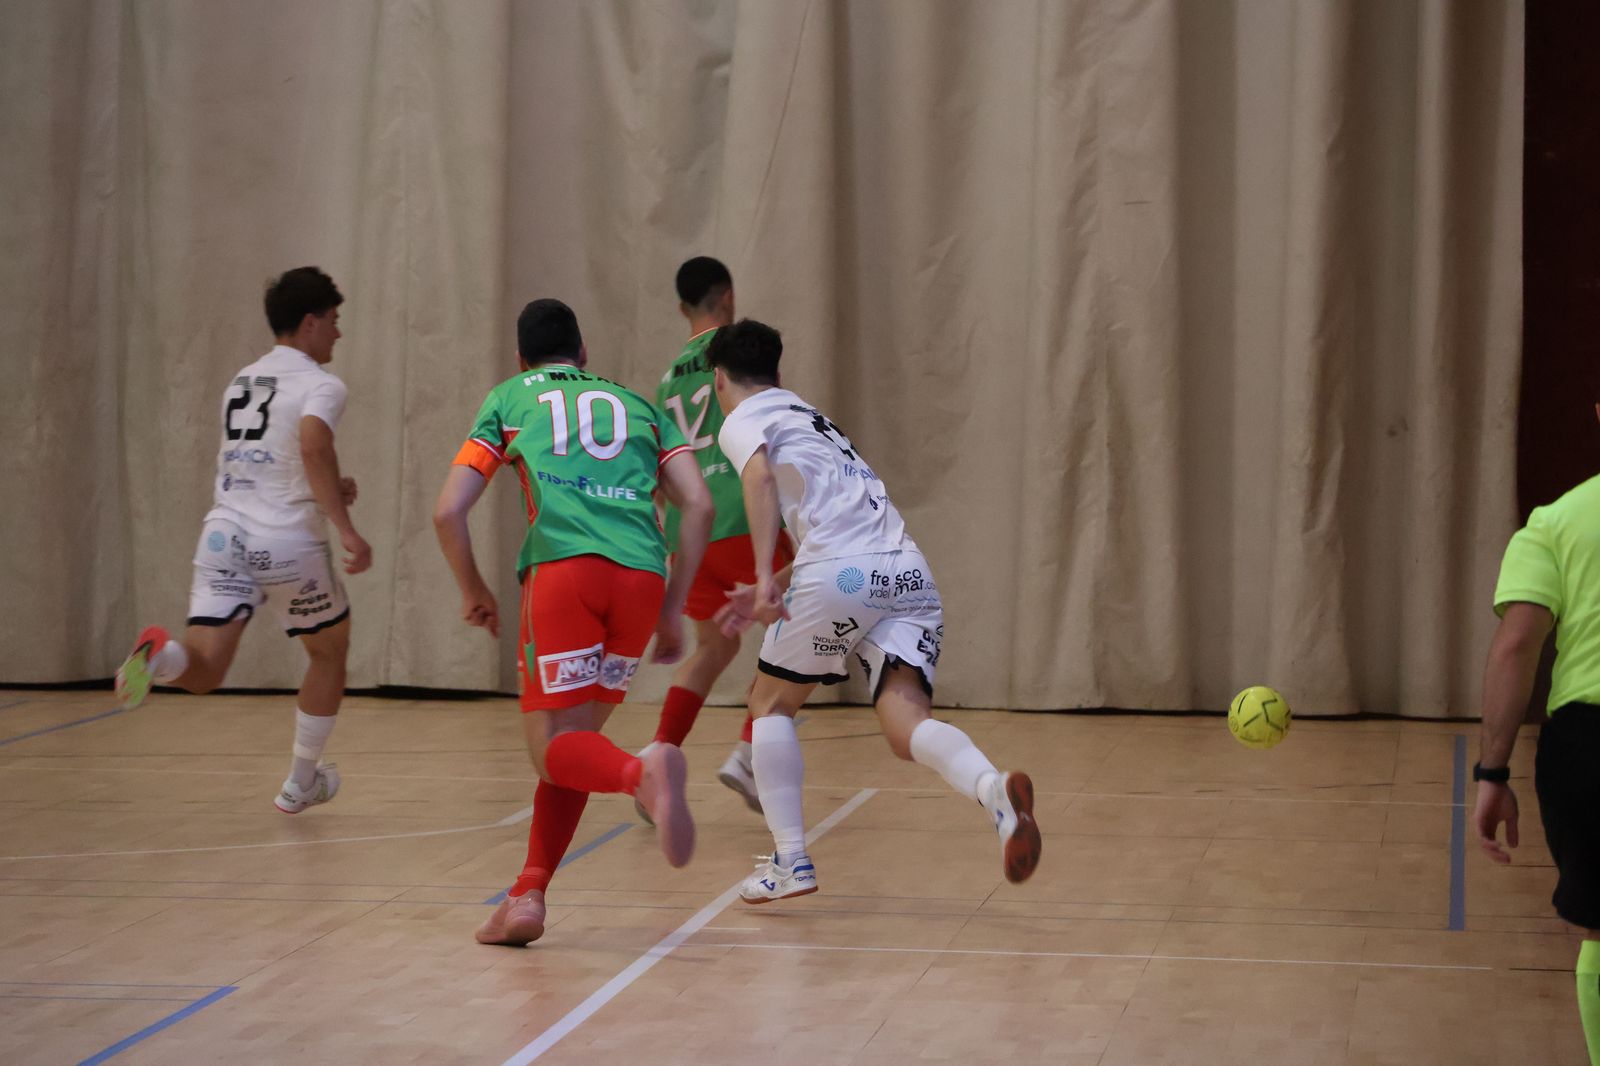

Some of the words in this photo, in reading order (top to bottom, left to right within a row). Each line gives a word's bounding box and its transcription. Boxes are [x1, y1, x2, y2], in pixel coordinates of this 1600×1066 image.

[224, 375, 278, 441] 23
[537, 388, 628, 461] 10
[664, 384, 715, 450] 12
